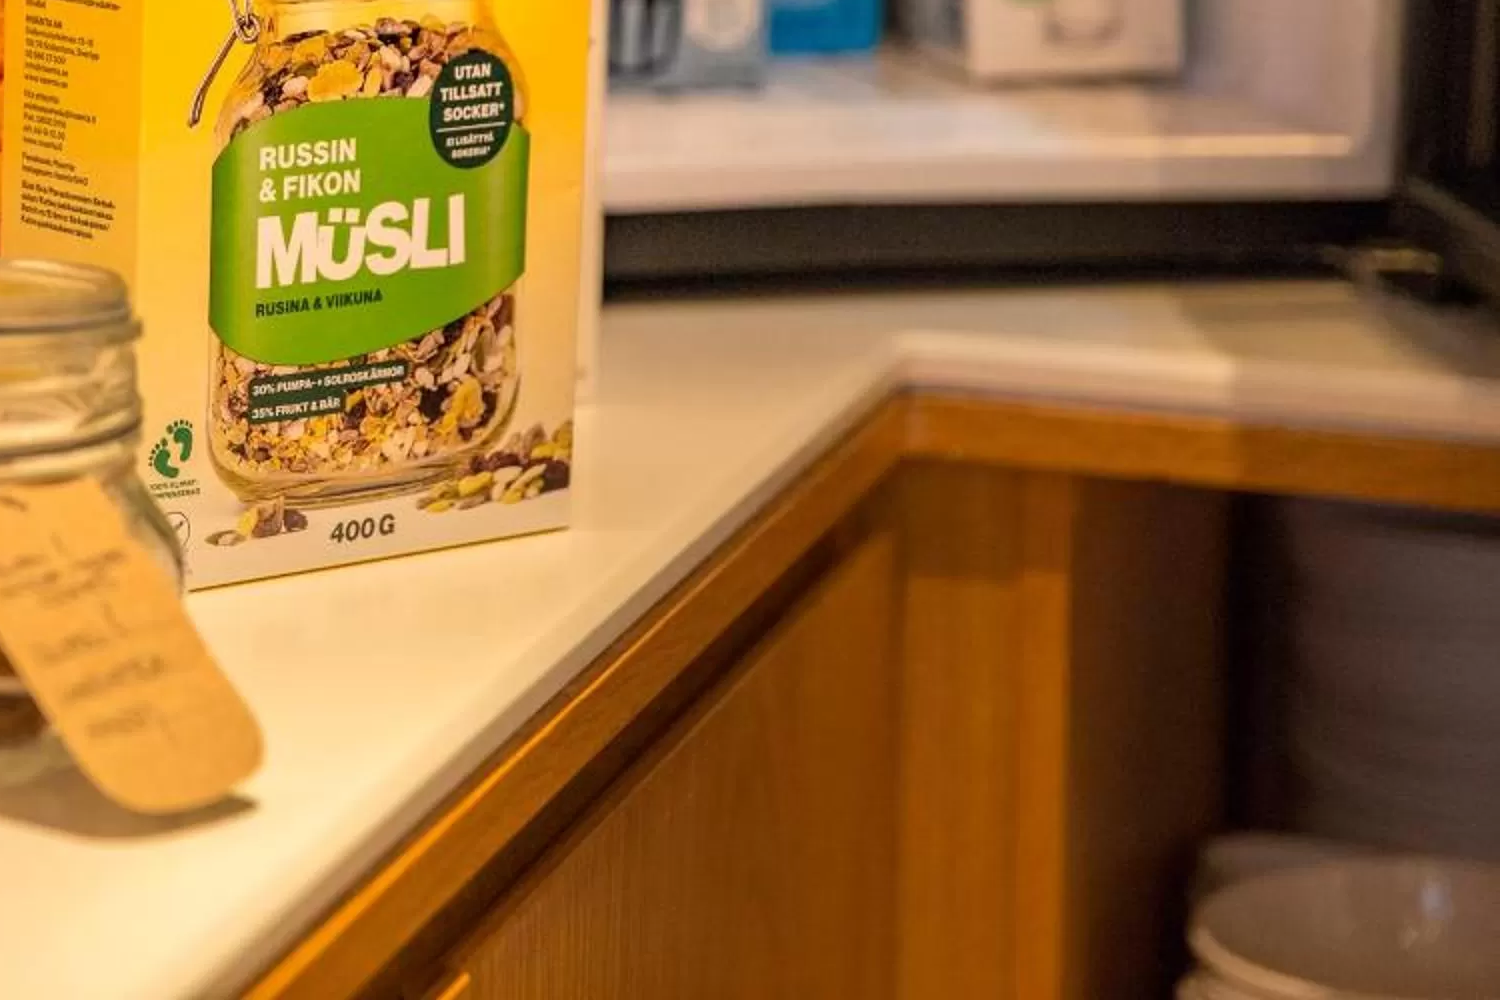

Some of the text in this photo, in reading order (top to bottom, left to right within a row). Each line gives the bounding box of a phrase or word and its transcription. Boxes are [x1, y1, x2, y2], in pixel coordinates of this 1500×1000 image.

[454, 62, 492, 81] UTAN
[440, 81, 503, 102] TILLSATT
[259, 137, 357, 171] RUSSIN
[259, 168, 361, 203] & FIKON
[255, 193, 466, 290] MÜSLI
[255, 288, 383, 318] RUSINA & VIIKUNA
[275, 400, 309, 417] FRUKT
[319, 396, 341, 411] BÄR
[330, 513, 396, 543] 400 G
